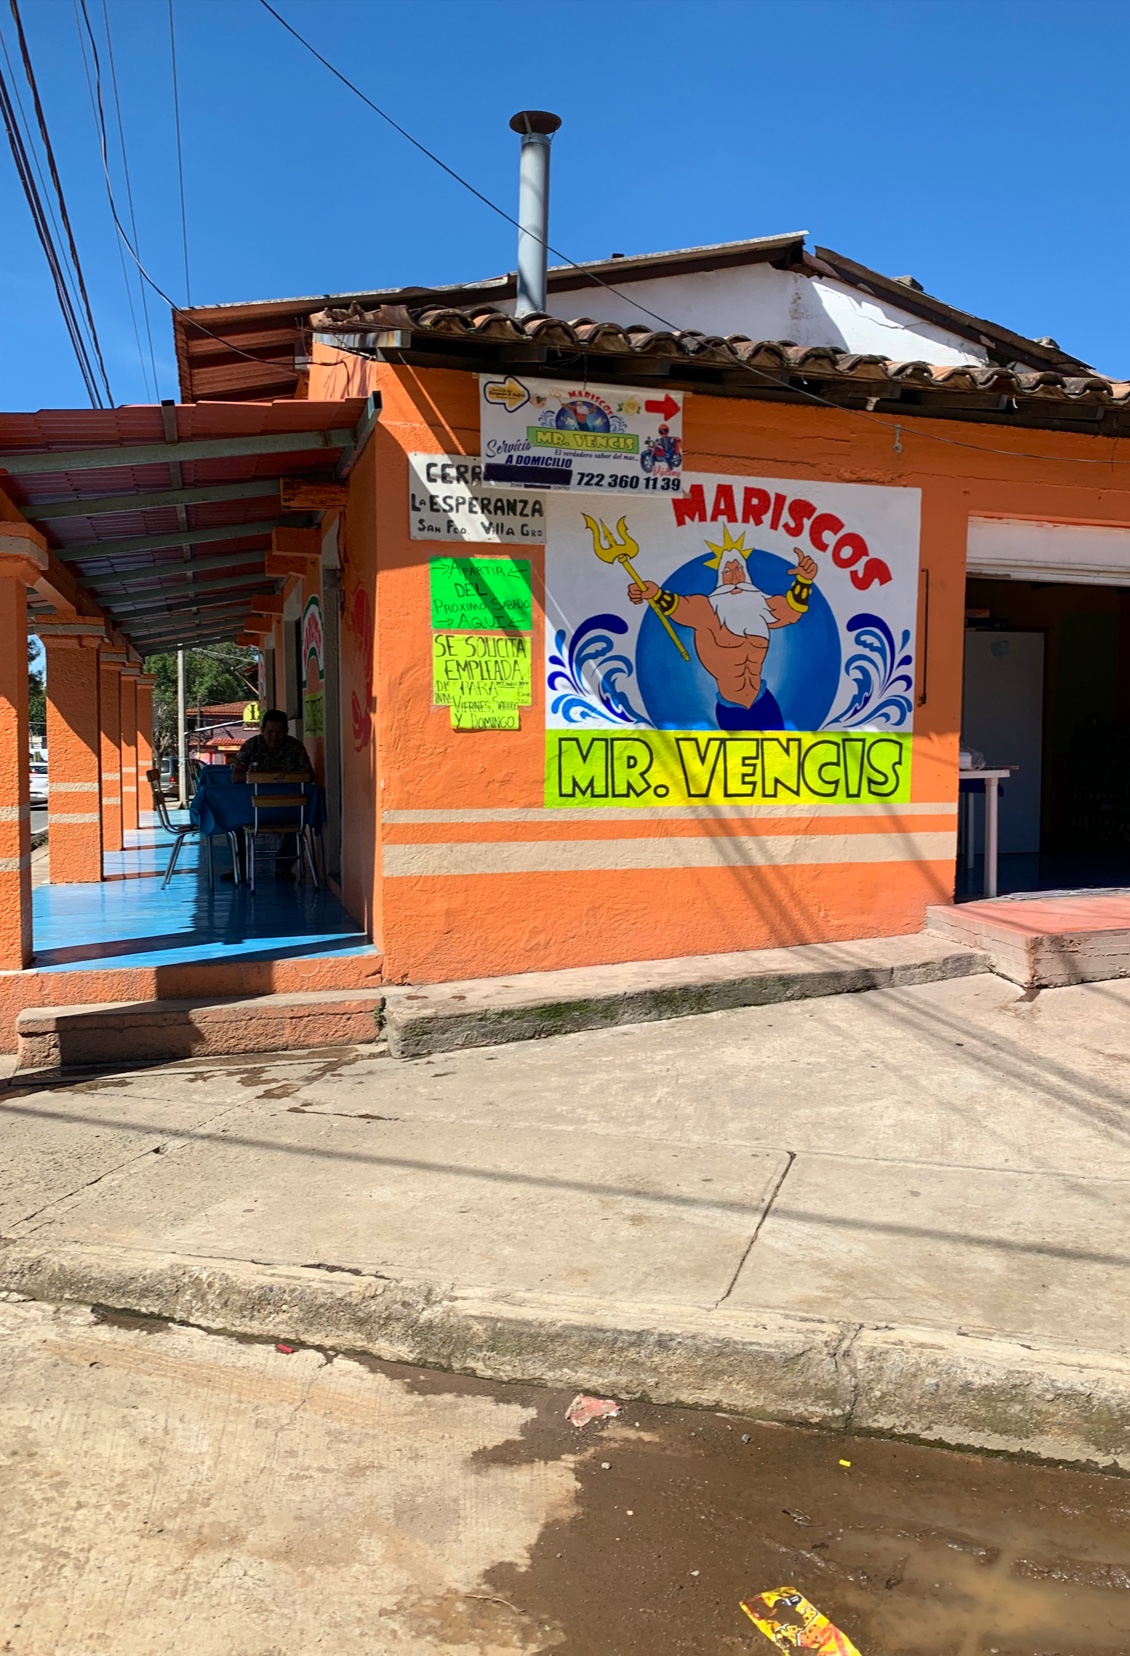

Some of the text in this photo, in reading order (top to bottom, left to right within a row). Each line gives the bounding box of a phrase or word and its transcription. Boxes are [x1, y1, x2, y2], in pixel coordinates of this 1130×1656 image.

[568, 390, 613, 416] MARISCOS
[485, 438, 532, 458] Servicio
[536, 431, 634, 450] MR. VENCIS
[505, 455, 573, 469] A DOMICILIO
[563, 450, 593, 458] verdadero
[426, 462, 482, 485] CERR
[576, 472, 681, 491] 722 360 11 39
[429, 495, 543, 517] ESPERANZA
[671, 483, 893, 591] MARISCOS
[454, 583, 488, 598] DEL
[434, 599, 487, 615] PROXIMO
[458, 613, 507, 629] AQUI
[435, 634, 527, 658] SE SOLICITA
[444, 659, 524, 681] EMPLEADA
[460, 681, 499, 696] PARA
[455, 713, 515, 729] Y DOMINGO
[558, 736, 903, 799] MR. VENCIS
